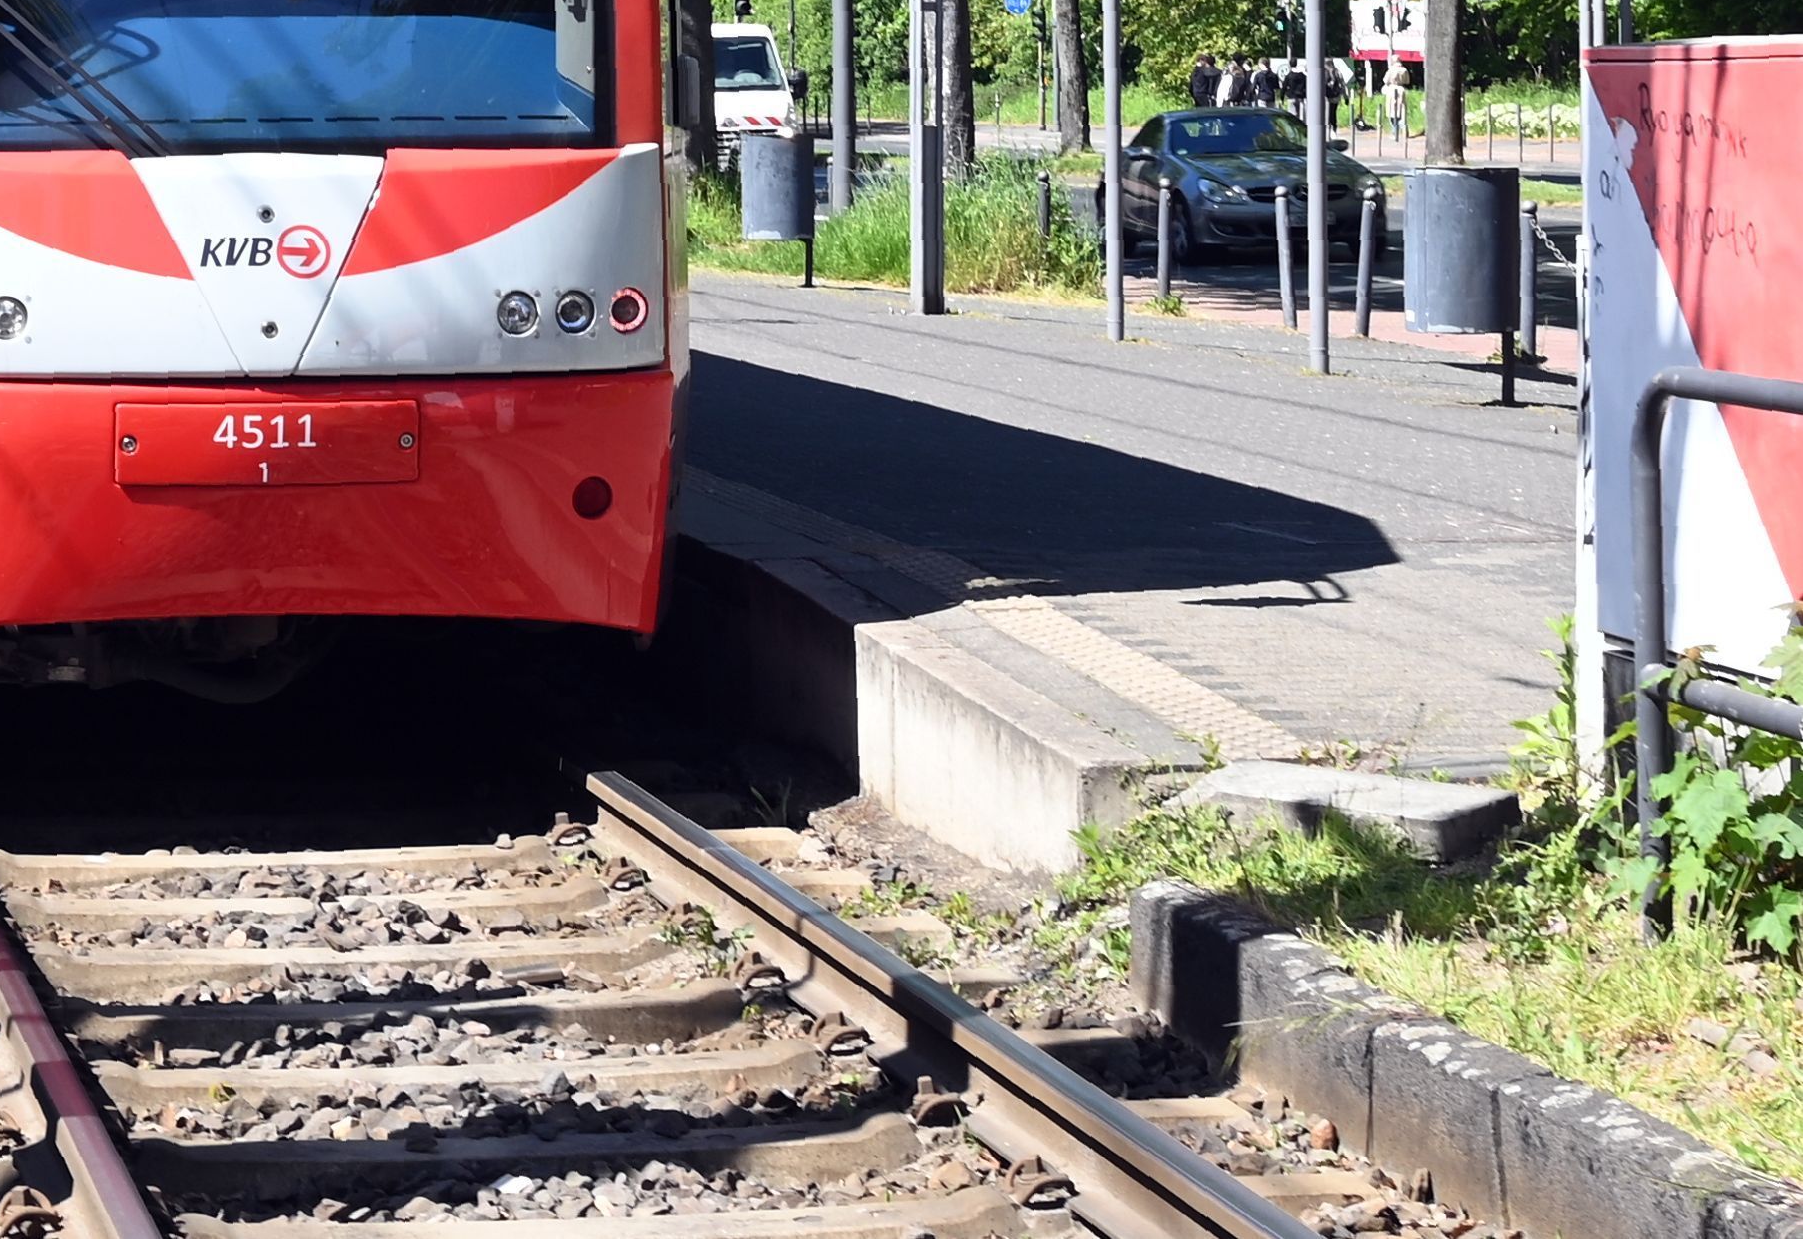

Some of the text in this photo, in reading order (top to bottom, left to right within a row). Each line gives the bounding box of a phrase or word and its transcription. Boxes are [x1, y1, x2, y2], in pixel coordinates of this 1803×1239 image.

[200, 237, 273, 267] KVB
[212, 414, 316, 449] 4511
[258, 462, 269, 484] 1
